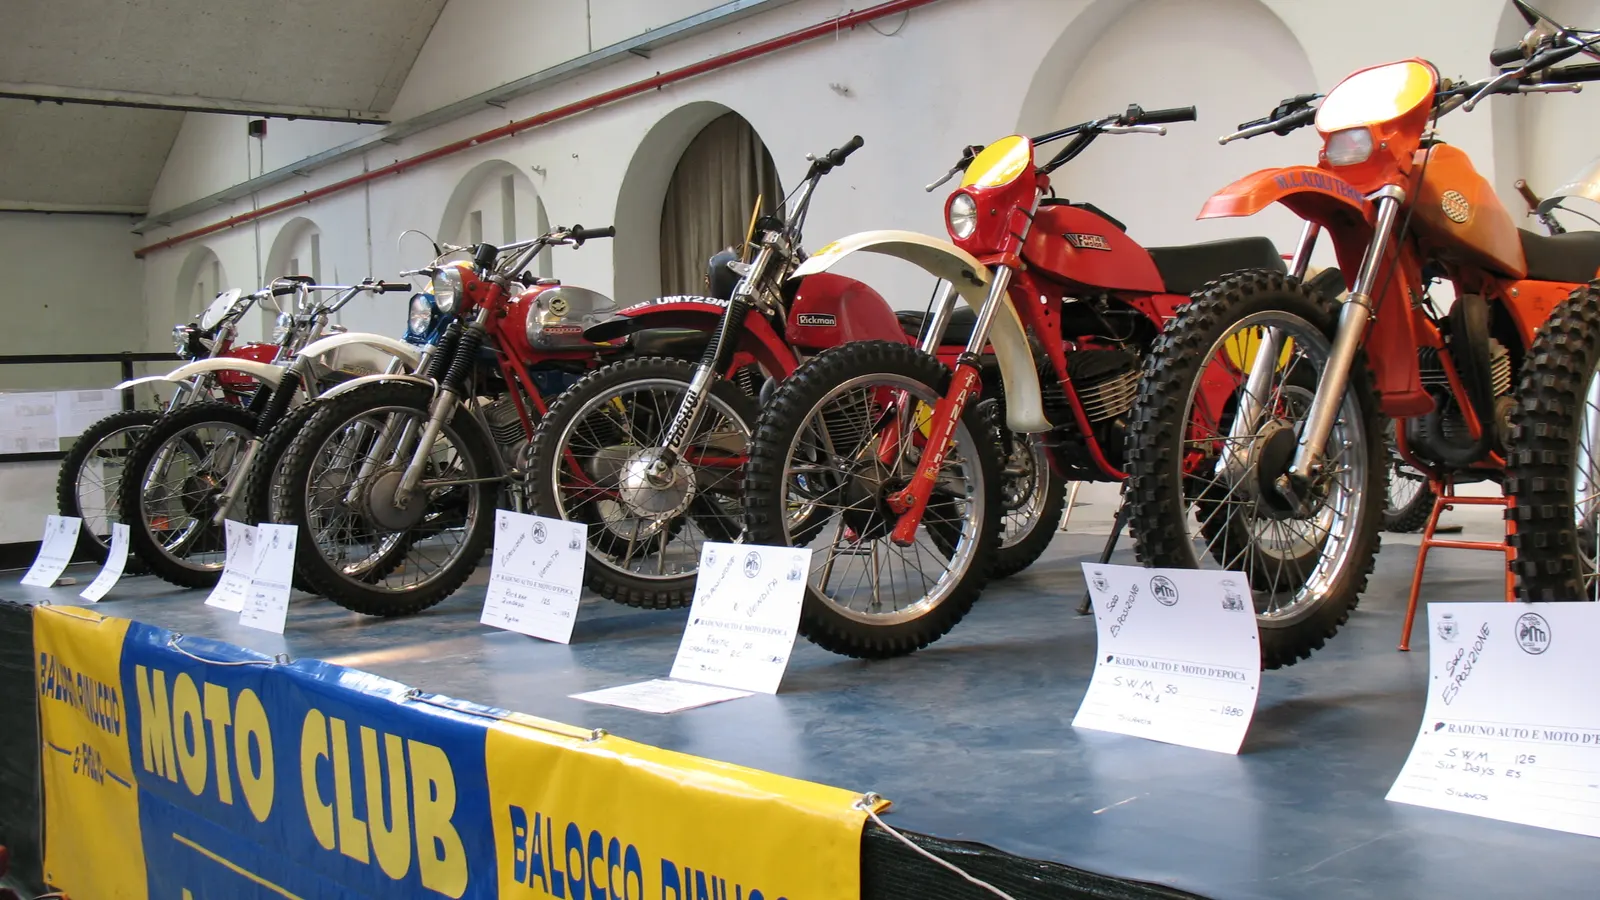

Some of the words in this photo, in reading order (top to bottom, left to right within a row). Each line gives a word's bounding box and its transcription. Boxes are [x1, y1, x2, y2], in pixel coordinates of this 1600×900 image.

[1115, 656, 1149, 668] RADUNO
[1149, 660, 1172, 672] AUTO
[1173, 663, 1179, 672] E
[1181, 664, 1206, 676] MOTO
[1208, 667, 1246, 681] D'EPOCA
[1441, 621, 1490, 706] ESPOSIZIONE
[1165, 684, 1179, 694] 50
[1448, 723, 1495, 737] RADUNO
[1497, 727, 1528, 740] AUTO
[1531, 729, 1540, 740] E
[1543, 730, 1579, 743] MOTO
[1515, 753, 1537, 765] 125
[134, 664, 275, 824] MOTO
[300, 708, 469, 900] CLUB
[508, 804, 644, 900] BALOCCO
